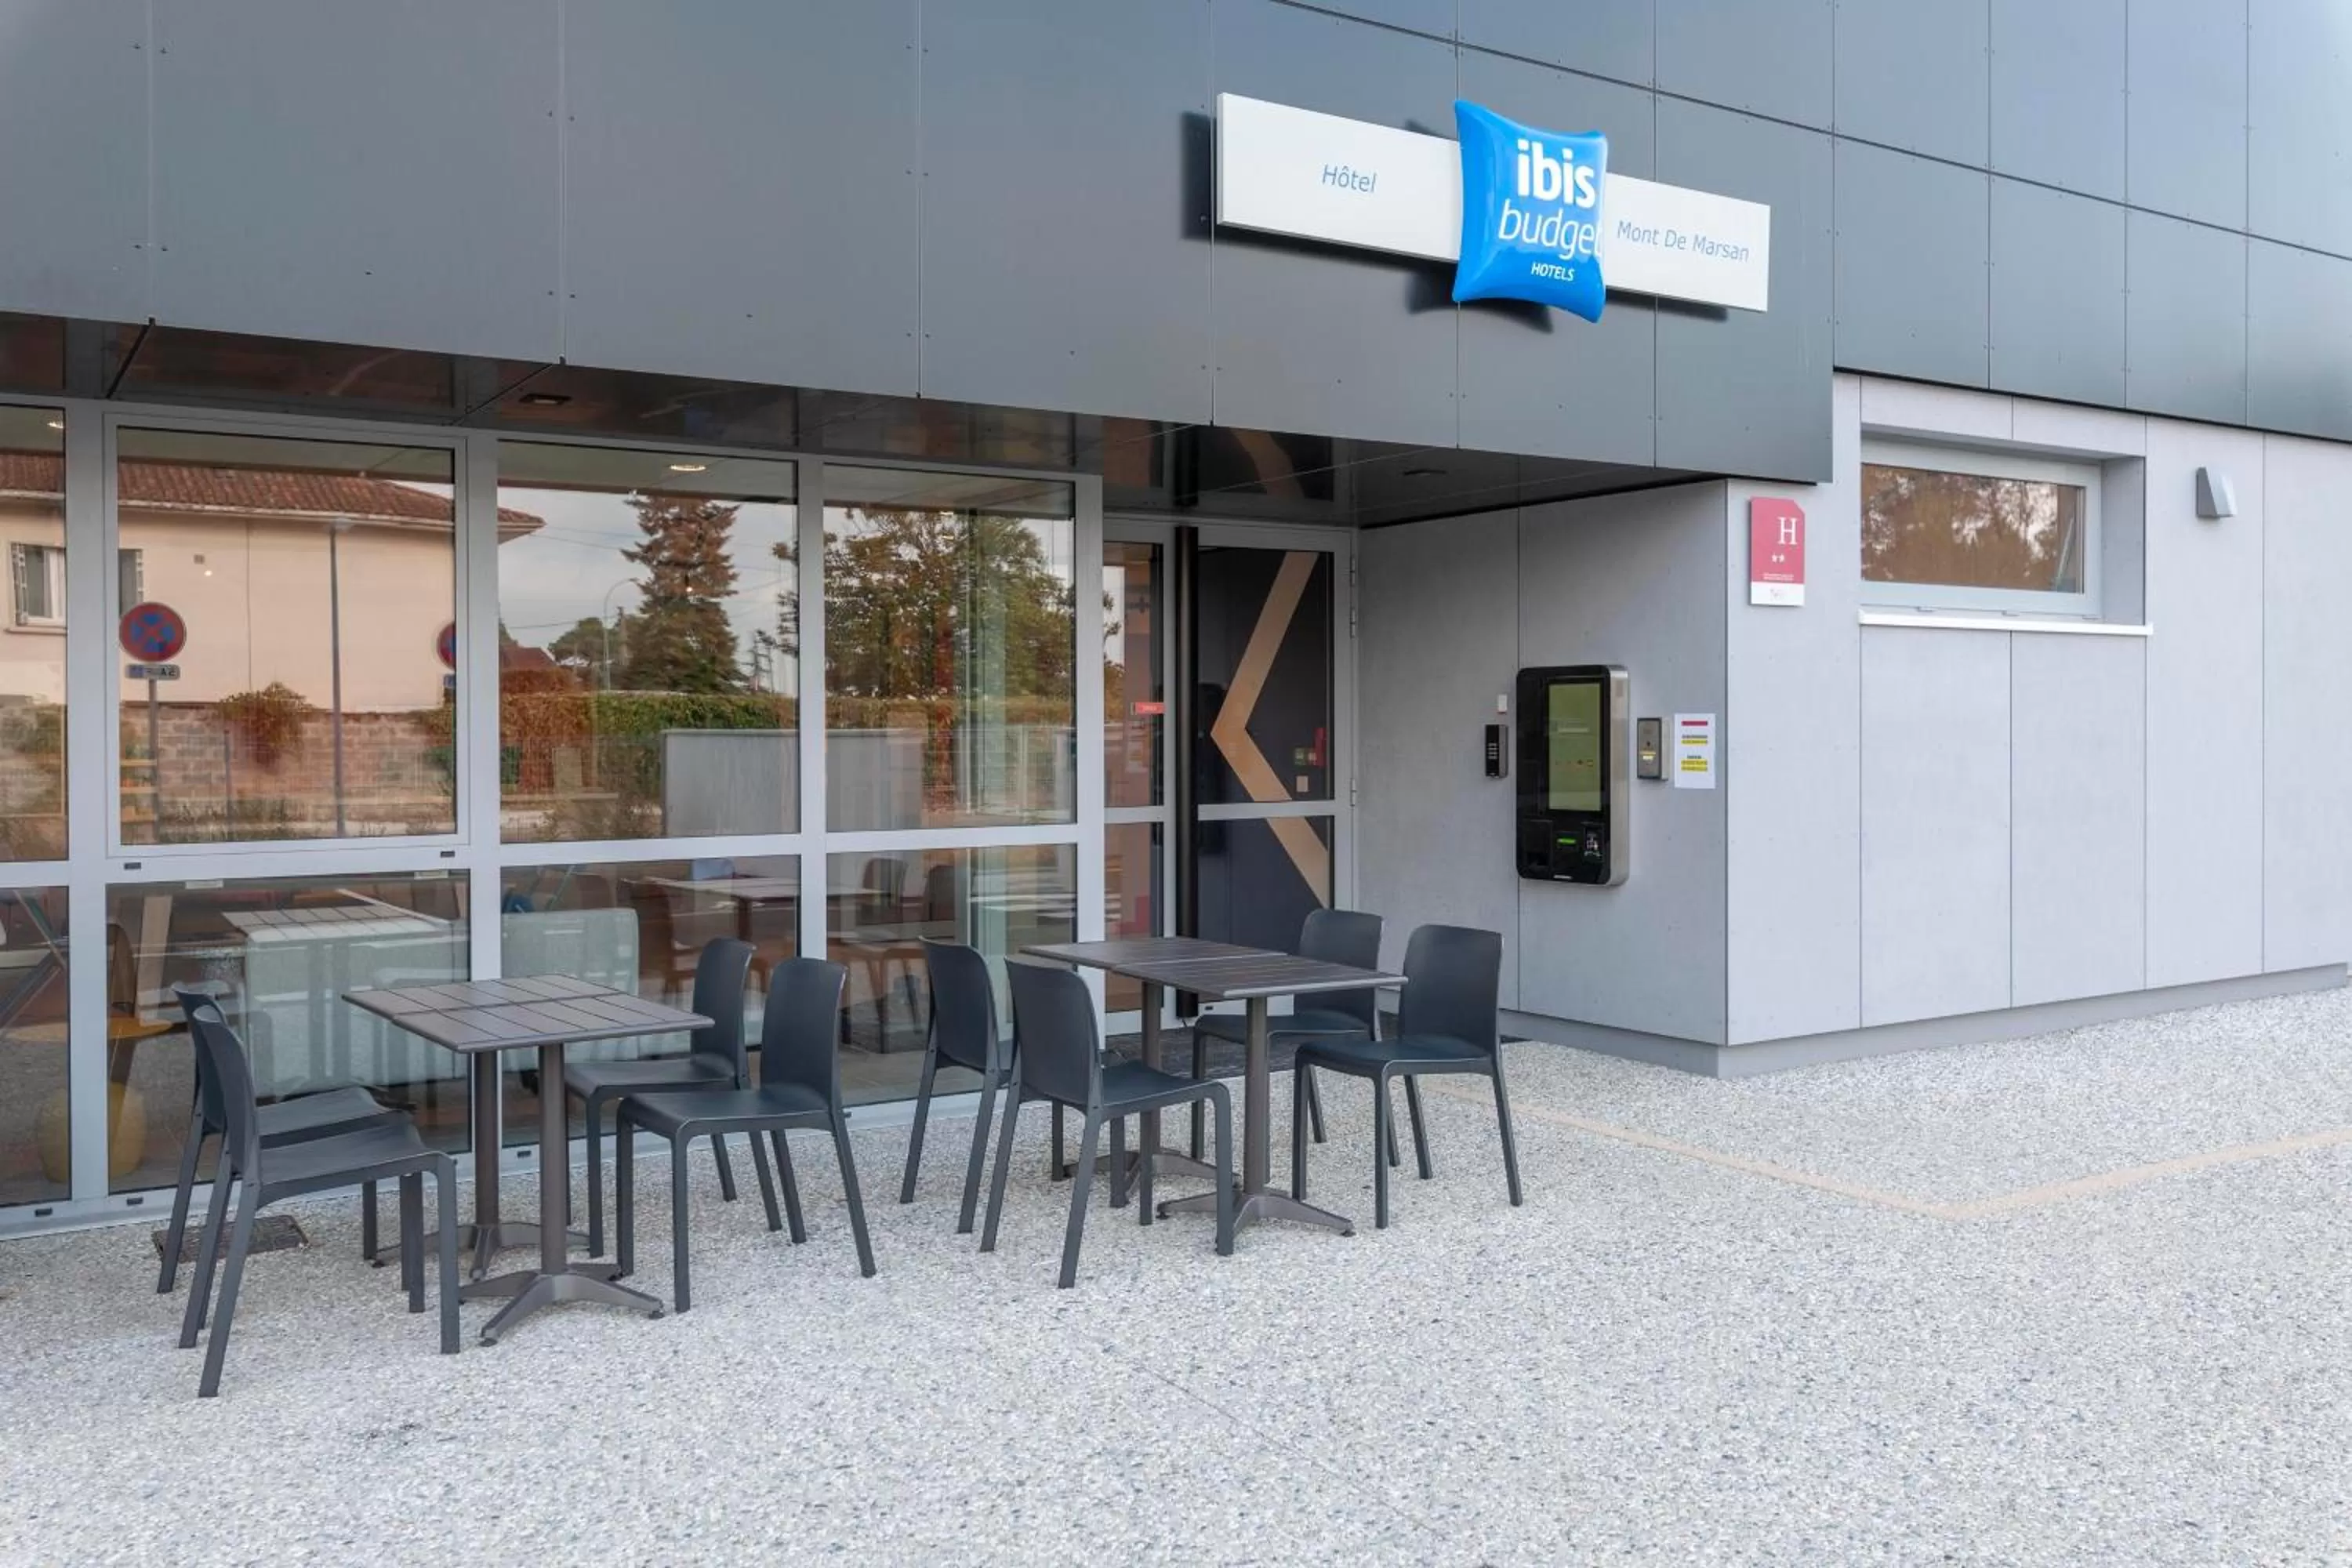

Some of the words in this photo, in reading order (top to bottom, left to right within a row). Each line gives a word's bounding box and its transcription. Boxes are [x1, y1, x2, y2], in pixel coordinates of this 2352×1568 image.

[1323, 164, 1377, 193] Hôtel
[1517, 139, 1595, 209] ibis
[1617, 220, 1660, 245] Mont
[1664, 230, 1686, 250] De
[1693, 234, 1750, 262] Marsan
[1531, 261, 1575, 281] HOTELS
[1777, 517, 1798, 545] H
